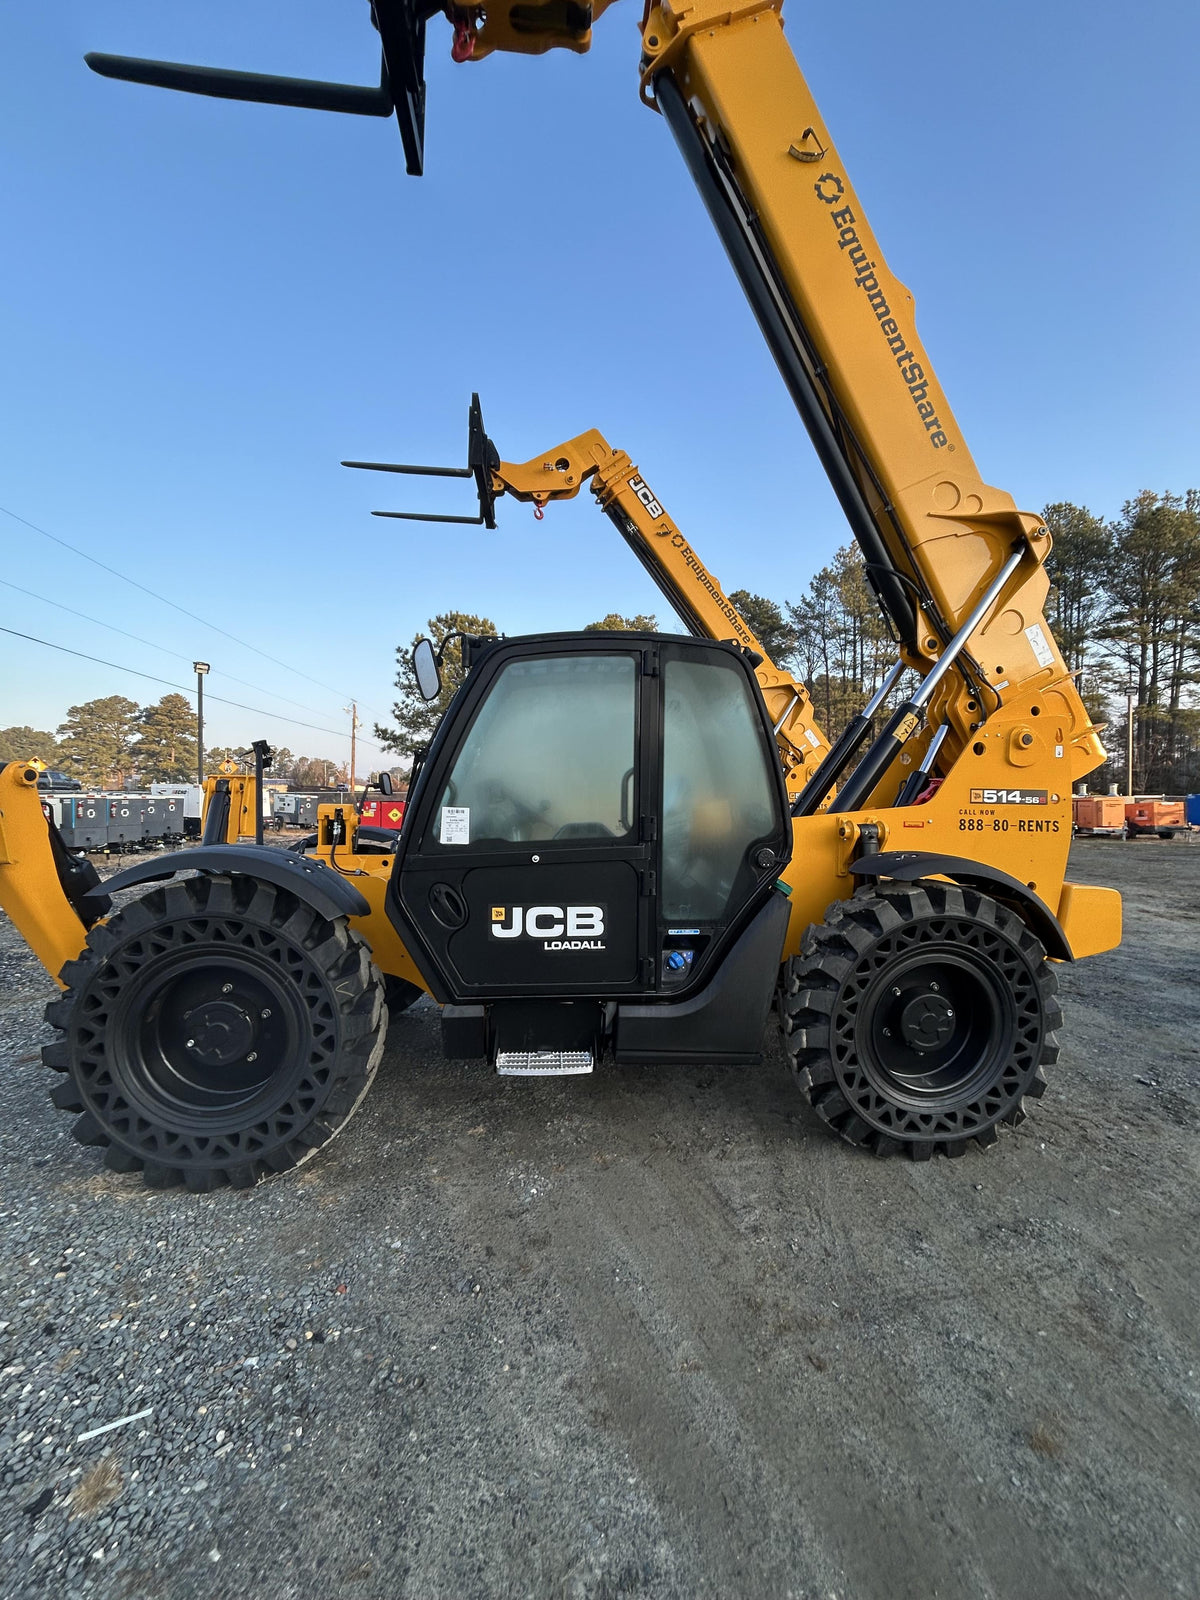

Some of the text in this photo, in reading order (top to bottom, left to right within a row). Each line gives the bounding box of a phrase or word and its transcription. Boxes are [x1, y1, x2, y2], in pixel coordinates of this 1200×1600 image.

[628, 478, 663, 519] JCB
[681, 546, 751, 644] EquipmentShare
[491, 906, 605, 938] JCB
[544, 940, 606, 950] LOADALL
